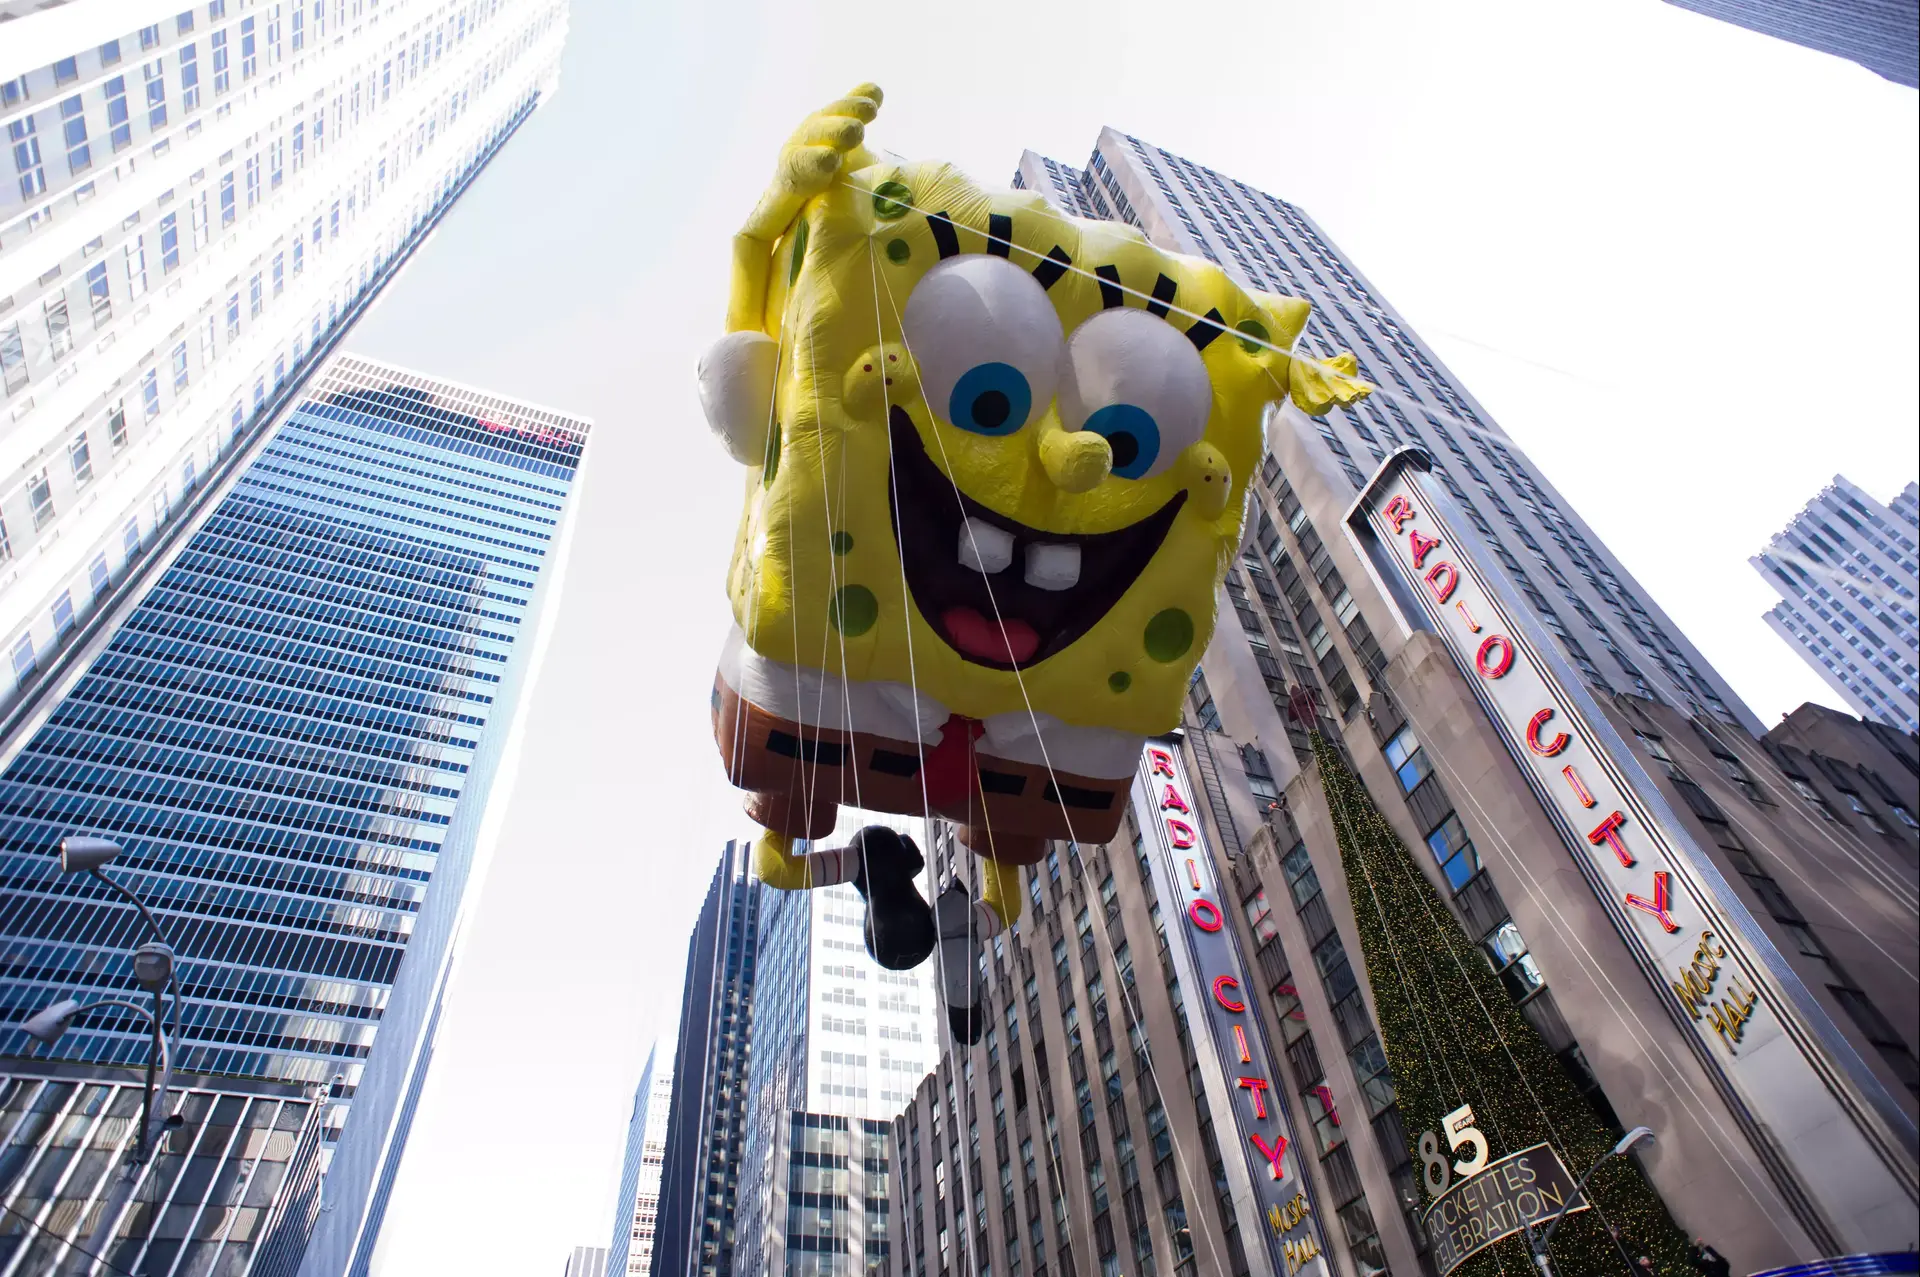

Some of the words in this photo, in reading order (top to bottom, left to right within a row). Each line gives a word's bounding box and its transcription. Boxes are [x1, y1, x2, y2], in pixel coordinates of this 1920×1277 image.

[1382, 494, 1513, 679] RADIO
[1526, 708, 1680, 934] CITY
[1147, 748, 1224, 932] RADIO
[1212, 974, 1289, 1181] CITY
[1673, 930, 1726, 1019] MUSIC
[1706, 974, 1757, 1056] HALL
[1418, 1103, 1489, 1197] 85
[1268, 1194, 1308, 1236] MUSIC
[1428, 1157, 1537, 1242] ROCKETTES
[1434, 1181, 1565, 1275] CELEBRATION
[1283, 1231, 1320, 1277] HALL
